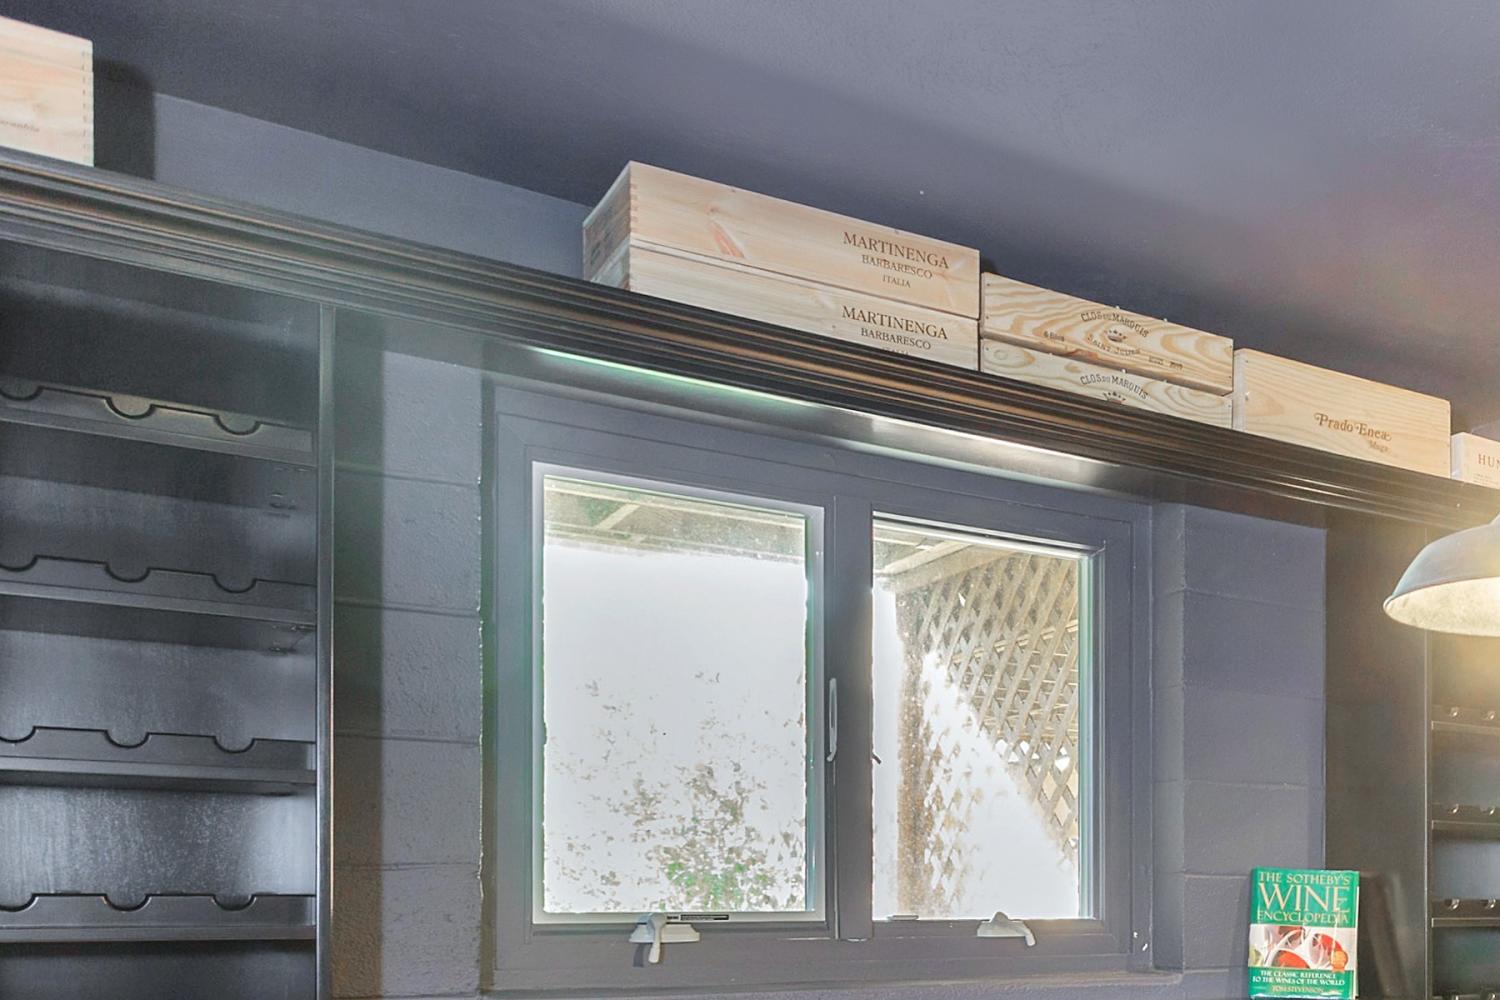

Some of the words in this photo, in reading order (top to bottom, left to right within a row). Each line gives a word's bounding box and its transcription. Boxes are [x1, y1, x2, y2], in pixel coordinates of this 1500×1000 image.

[843, 232, 949, 269] MARTINENGA
[862, 255, 932, 279] BARBARESCO
[883, 275, 911, 288] ITALIA
[842, 306, 948, 339] MARTINENGA
[1080, 311, 1103, 322] CLOS
[861, 328, 931, 350] BARBARESCO
[1080, 373, 1102, 385] CLOS
[1111, 375, 1149, 400] MARQUIS
[1314, 412, 1354, 432] Prado
[1258, 872, 1282, 883] THE
[1286, 873, 1351, 886] SOTHEBY'S
[1258, 883, 1351, 913] WINE
[1257, 910, 1350, 924] ENCYCLOPEDIA
[1300, 972, 1337, 980] REFERENCE
[1319, 979, 1346, 987] WORLD
